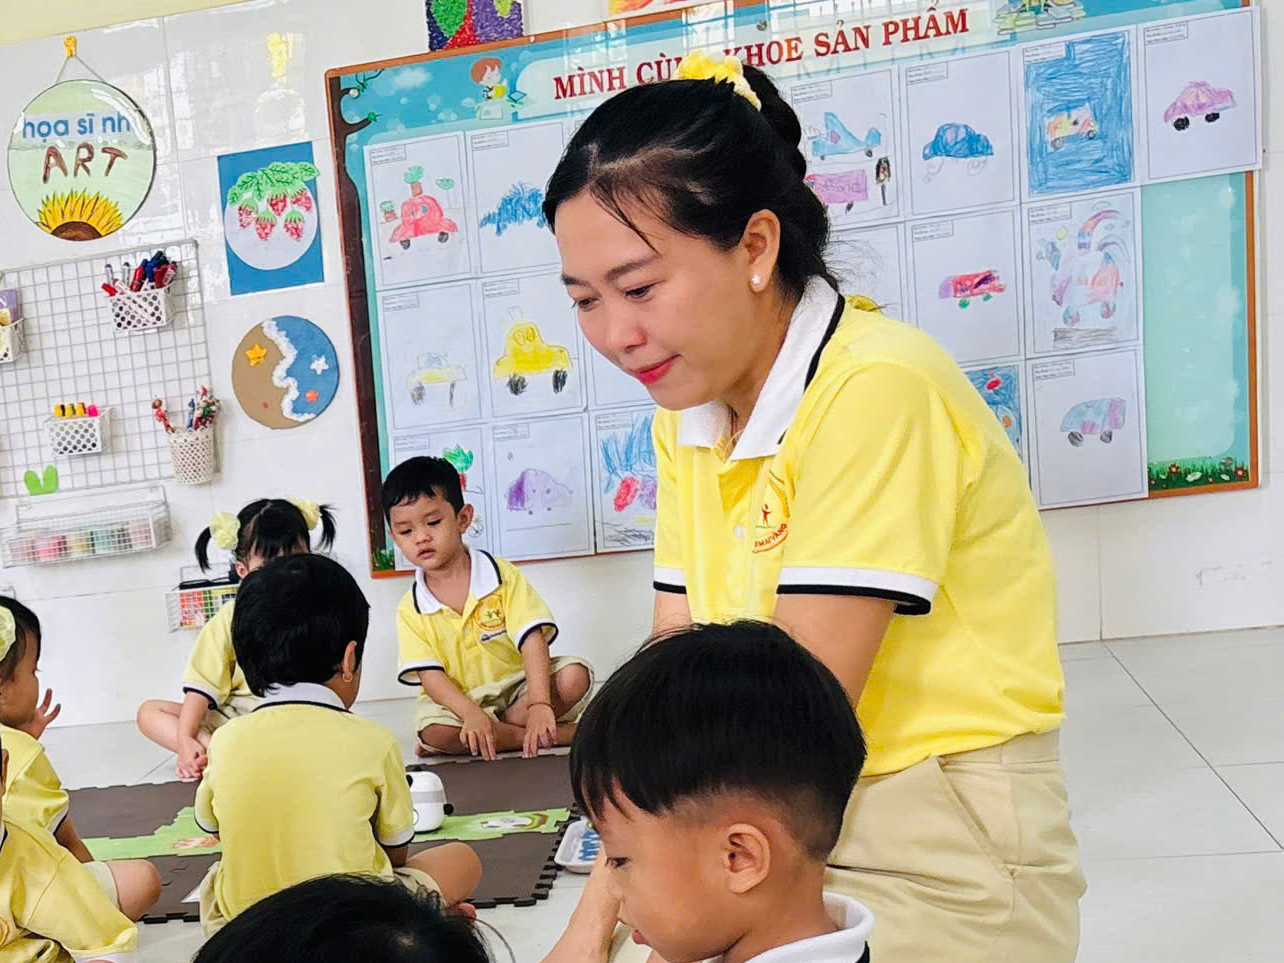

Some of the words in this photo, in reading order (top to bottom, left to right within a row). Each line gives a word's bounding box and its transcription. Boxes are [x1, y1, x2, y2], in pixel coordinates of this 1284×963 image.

[553, 66, 627, 99] MÌNH
[636, 52, 682, 85] CÙ
[814, 20, 871, 57] SẢN
[22, 117, 69, 143] họa
[77, 112, 95, 135] sĩ
[102, 111, 131, 133] nh
[42, 142, 128, 184] ART
